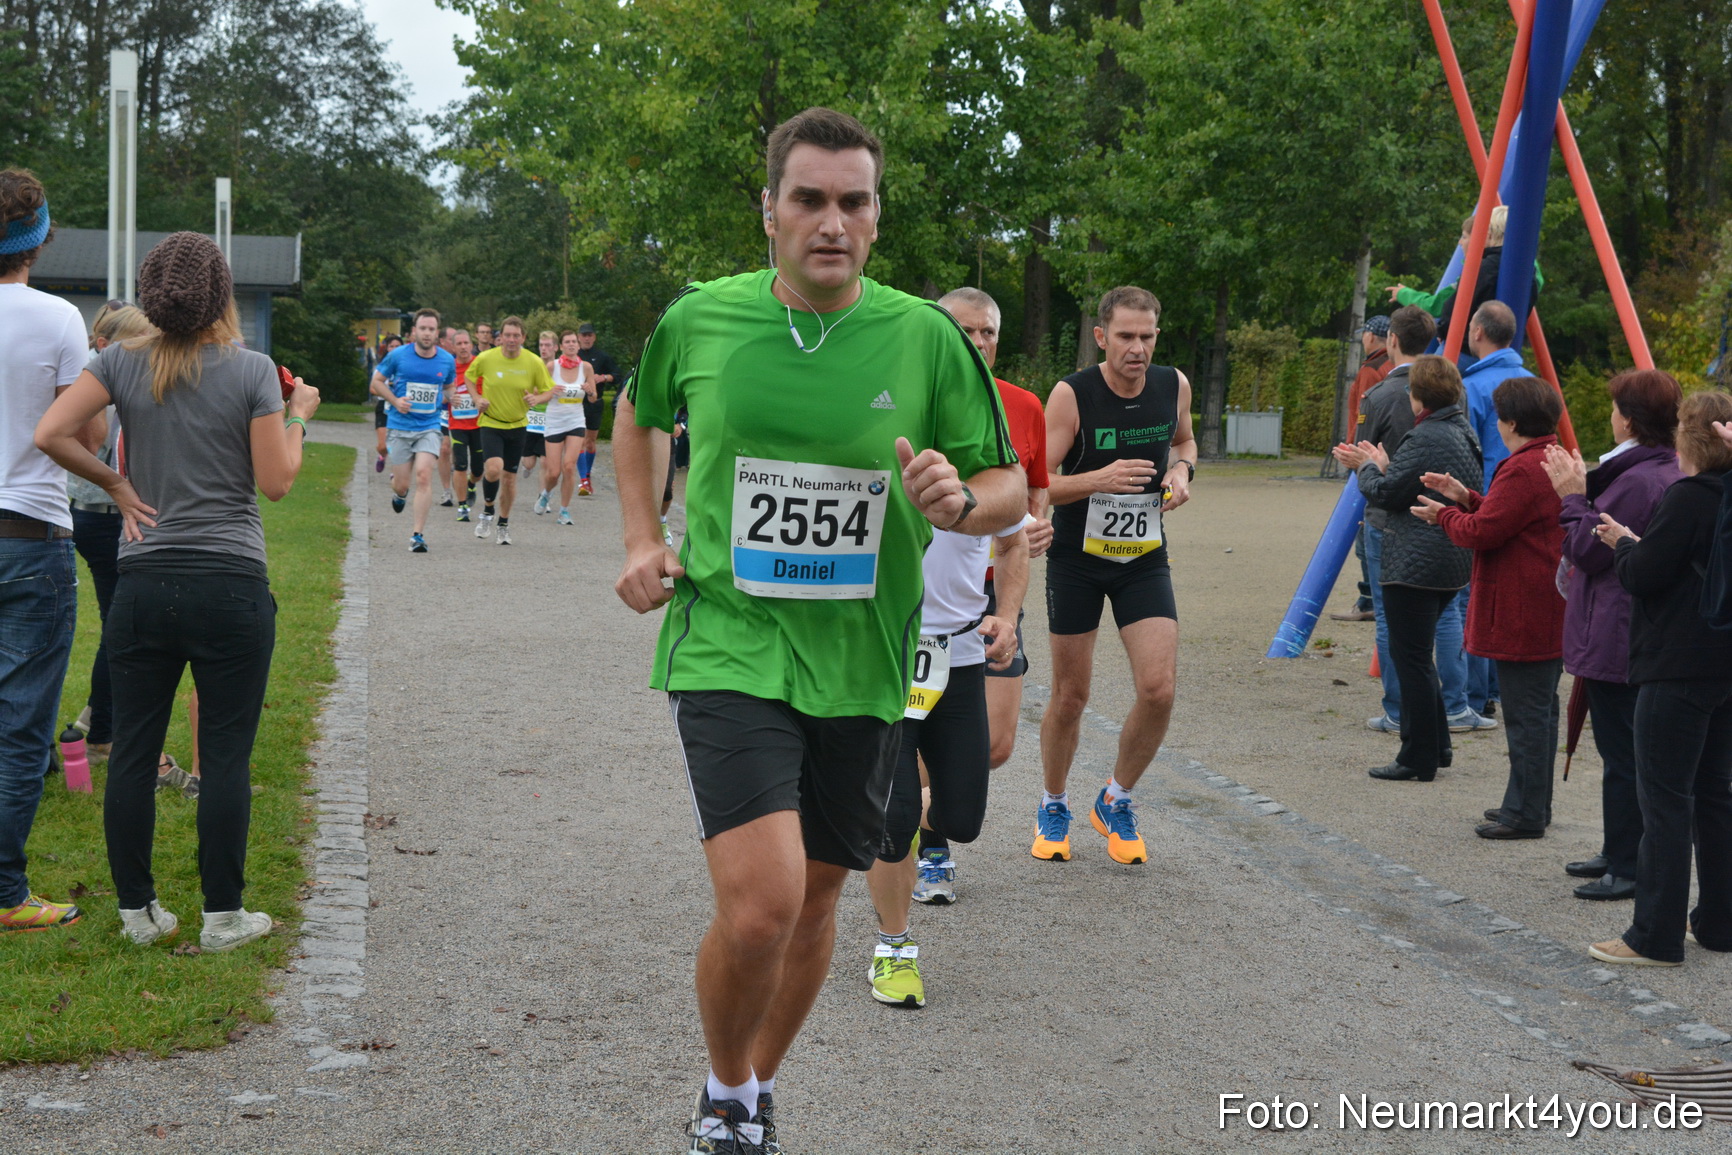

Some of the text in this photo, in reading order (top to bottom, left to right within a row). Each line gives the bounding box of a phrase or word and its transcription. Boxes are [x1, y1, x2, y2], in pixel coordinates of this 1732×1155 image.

[409, 390, 436, 402] 3386
[1126, 438, 1151, 446] PREMIUM
[738, 471, 862, 492] PARTL Neumarkt
[1091, 497, 1151, 509] PARTL Neumarkt
[747, 493, 869, 548] 2554
[1102, 511, 1147, 538] 226
[1102, 543, 1144, 554] Andreas
[773, 558, 836, 580] Daniel
[917, 638, 937, 648] arkt
[909, 693, 925, 707] ph
